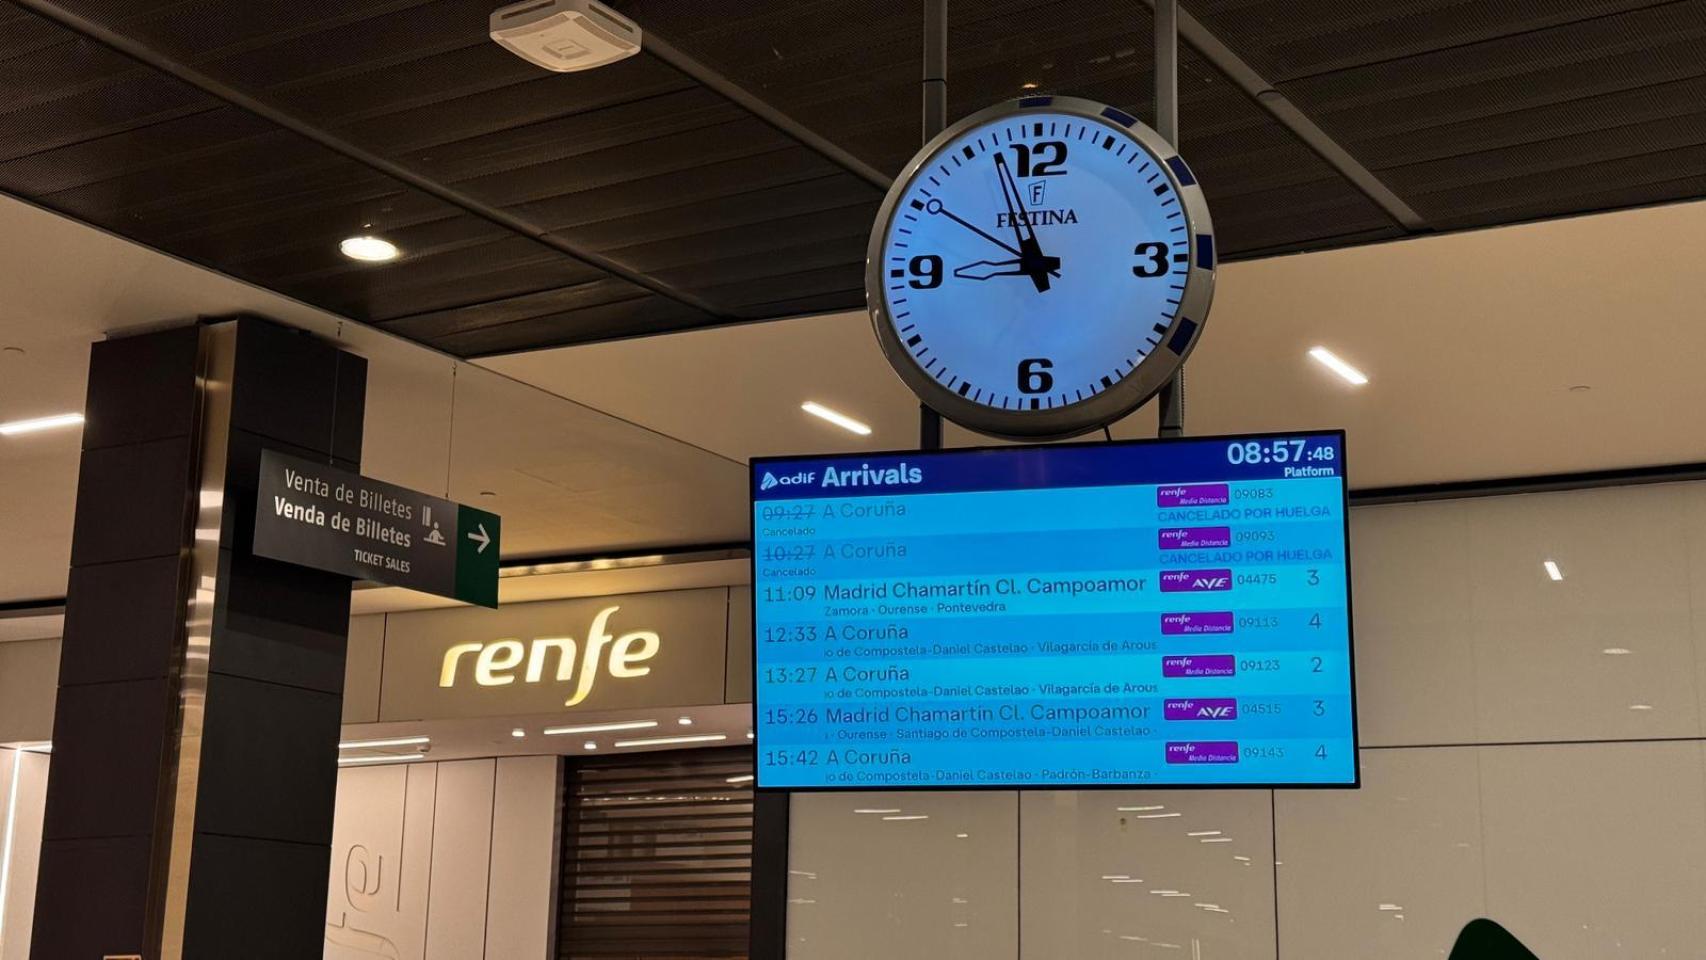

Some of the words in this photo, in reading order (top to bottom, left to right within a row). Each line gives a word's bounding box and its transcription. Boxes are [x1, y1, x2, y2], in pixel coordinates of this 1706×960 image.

[1009, 141, 1068, 177] 12
[996, 208, 1078, 228] FESTINA
[1132, 242, 1169, 278] 3
[908, 255, 943, 289] 9
[1017, 358, 1053, 394] 6
[779, 471, 817, 485] adif
[821, 462, 923, 488] Arrivals
[1284, 466, 1335, 477] Platform
[285, 468, 329, 498] Venta
[335, 483, 354, 504] de
[359, 489, 412, 520] Billetes
[1160, 488, 1187, 499] renfe
[762, 504, 817, 521] 09:27
[823, 504, 836, 519] A
[840, 502, 907, 518] Coruña
[1158, 508, 1242, 522] CANCELADO
[1244, 507, 1273, 519] POR
[1275, 505, 1331, 518] HUELGA
[274, 496, 325, 527] Venda
[331, 511, 351, 532] de
[356, 516, 411, 548] Billetes
[762, 526, 817, 537] Cancelado
[1161, 530, 1189, 541] renfe
[762, 544, 817, 562] 10:27
[823, 545, 837, 560] A
[840, 543, 908, 560] Coruña
[1159, 551, 1244, 565] CANCELADO
[1246, 550, 1275, 563] POR
[1277, 548, 1333, 561] HUELGA
[354, 549, 384, 567] TICKET
[385, 557, 411, 574] SALES
[762, 567, 817, 578] Cancelado
[1163, 573, 1190, 584] renfe
[1237, 574, 1277, 586] 04475
[1306, 569, 1320, 586] 3
[765, 585, 817, 603] 11:09
[824, 583, 888, 601] Madrid
[892, 579, 990, 599] Chamartín
[1027, 577, 1147, 598] Campoamor
[1192, 577, 1229, 590] AVE
[825, 606, 870, 617] Zamora
[877, 604, 928, 616] Ourense
[937, 600, 1007, 614] Pontevedra
[1164, 614, 1191, 625] renfe
[1308, 612, 1323, 630] 4
[765, 625, 817, 643] 12:33
[825, 625, 837, 641] A
[842, 624, 909, 642] Coruña
[439, 606, 661, 707] renfe
[837, 648, 851, 657] de
[854, 644, 970, 657] Compostela-Daniel
[974, 642, 1029, 655] Castelao
[1102, 640, 1118, 652] de
[1166, 657, 1193, 667] renfe
[1311, 656, 1323, 673] 2
[766, 666, 817, 684] 13:27
[825, 666, 838, 682] A
[843, 665, 910, 682] Coruña
[837, 689, 852, 699] de
[855, 685, 972, 699] Compostela-Daniel
[975, 683, 1030, 697] Castelao
[1103, 681, 1121, 694] de
[766, 707, 819, 725] 15:26
[826, 706, 890, 724] Madrid
[1030, 702, 1151, 723] Campoamor
[1167, 700, 1194, 711] renfe
[1197, 706, 1234, 718] AVE
[1313, 699, 1326, 717] 3
[837, 728, 888, 740] Ourense
[896, 726, 949, 740] Santiago
[952, 726, 968, 738] de
[970, 723, 1091, 739] Compostela-Daniel
[1095, 724, 1151, 736] Castelao
[1169, 743, 1196, 754] renfe
[1315, 745, 1328, 761] 4
[767, 749, 819, 767] 15:42
[827, 749, 839, 765] A
[844, 748, 912, 766] Coruña
[839, 772, 854, 782] de
[857, 769, 973, 783] Compostela-Daniel
[977, 768, 1033, 781] Castelao
[1042, 768, 1151, 781] Padrón-Barbanza
